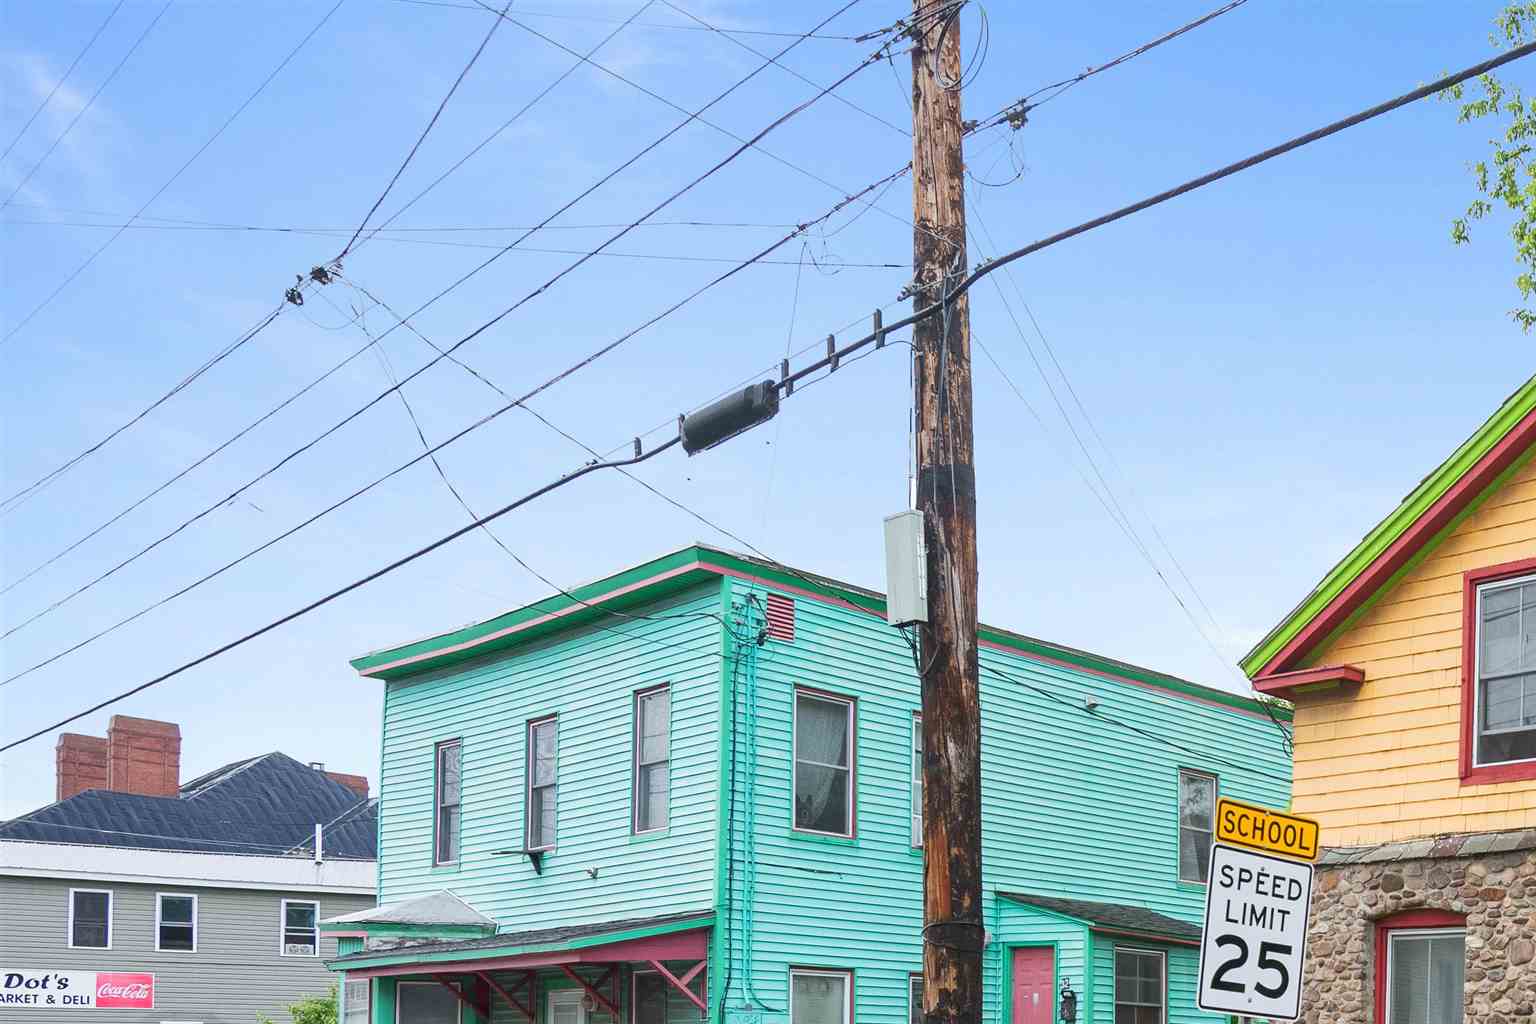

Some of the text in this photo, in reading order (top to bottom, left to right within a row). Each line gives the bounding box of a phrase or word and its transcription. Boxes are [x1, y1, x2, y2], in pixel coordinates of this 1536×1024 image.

[1223, 809, 1311, 851] SCHOOL
[1219, 864, 1303, 901] SPEED
[1225, 899, 1291, 932] LIMIT
[4, 973, 69, 990] Dot's
[1210, 934, 1293, 999] 25
[0, 993, 90, 1005] ARKET & DELI
